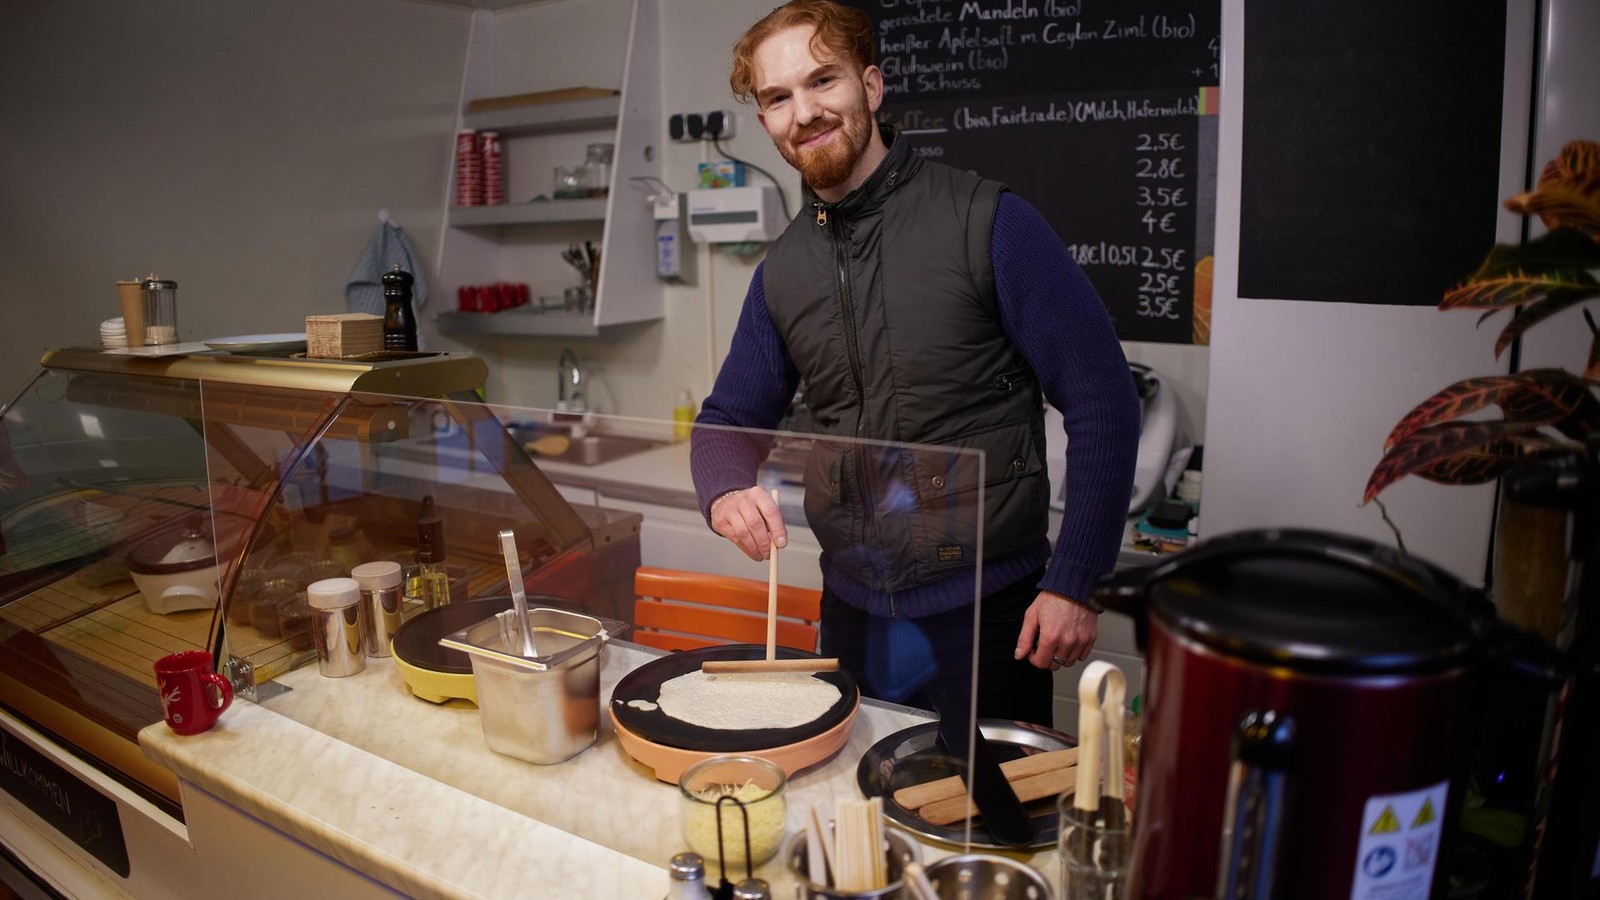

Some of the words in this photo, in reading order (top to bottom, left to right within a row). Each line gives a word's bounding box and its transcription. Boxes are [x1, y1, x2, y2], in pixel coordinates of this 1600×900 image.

[958, 0, 1039, 22] Mandeln
[1044, 0, 1081, 17] (bio)
[937, 25, 1014, 55] Apfelsaft
[1043, 22, 1098, 49] Ceylon
[1152, 13, 1195, 39] (bio)
[968, 47, 1008, 70] (bio)
[917, 73, 982, 92] Schuss
